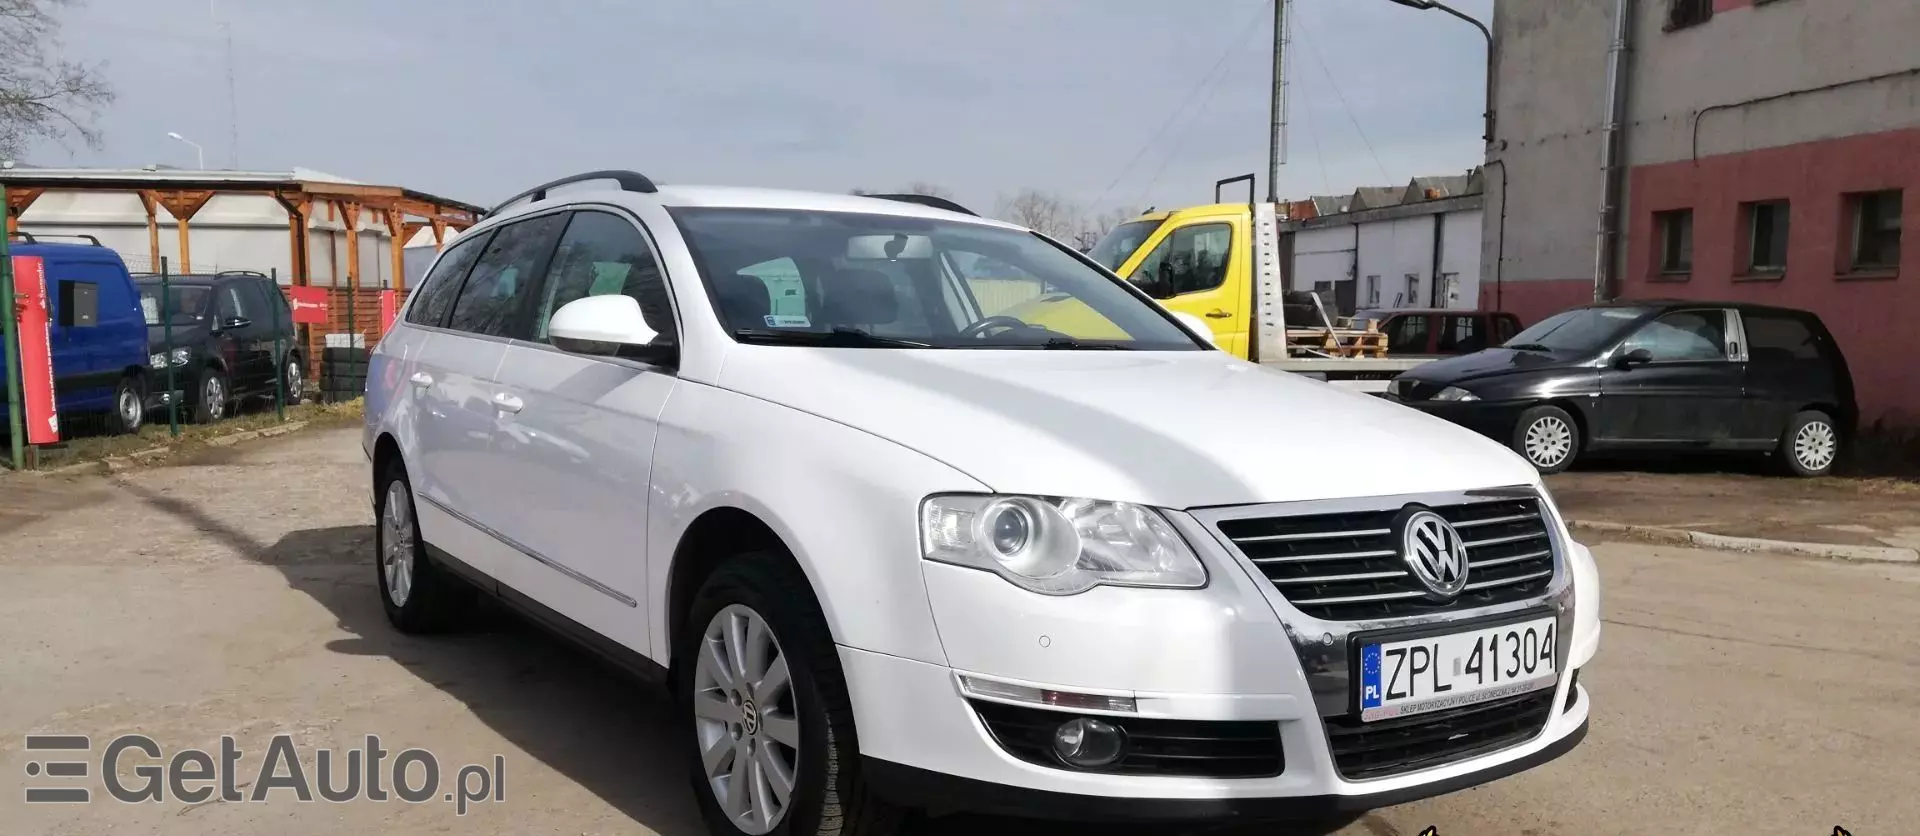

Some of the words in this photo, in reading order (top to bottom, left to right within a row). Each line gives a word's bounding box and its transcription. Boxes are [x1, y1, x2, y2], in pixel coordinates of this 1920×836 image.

[1412, 518, 1463, 586] VW
[1365, 685, 1380, 700] PL
[1385, 643, 1453, 701] ZPL
[1464, 622, 1554, 685] 41304
